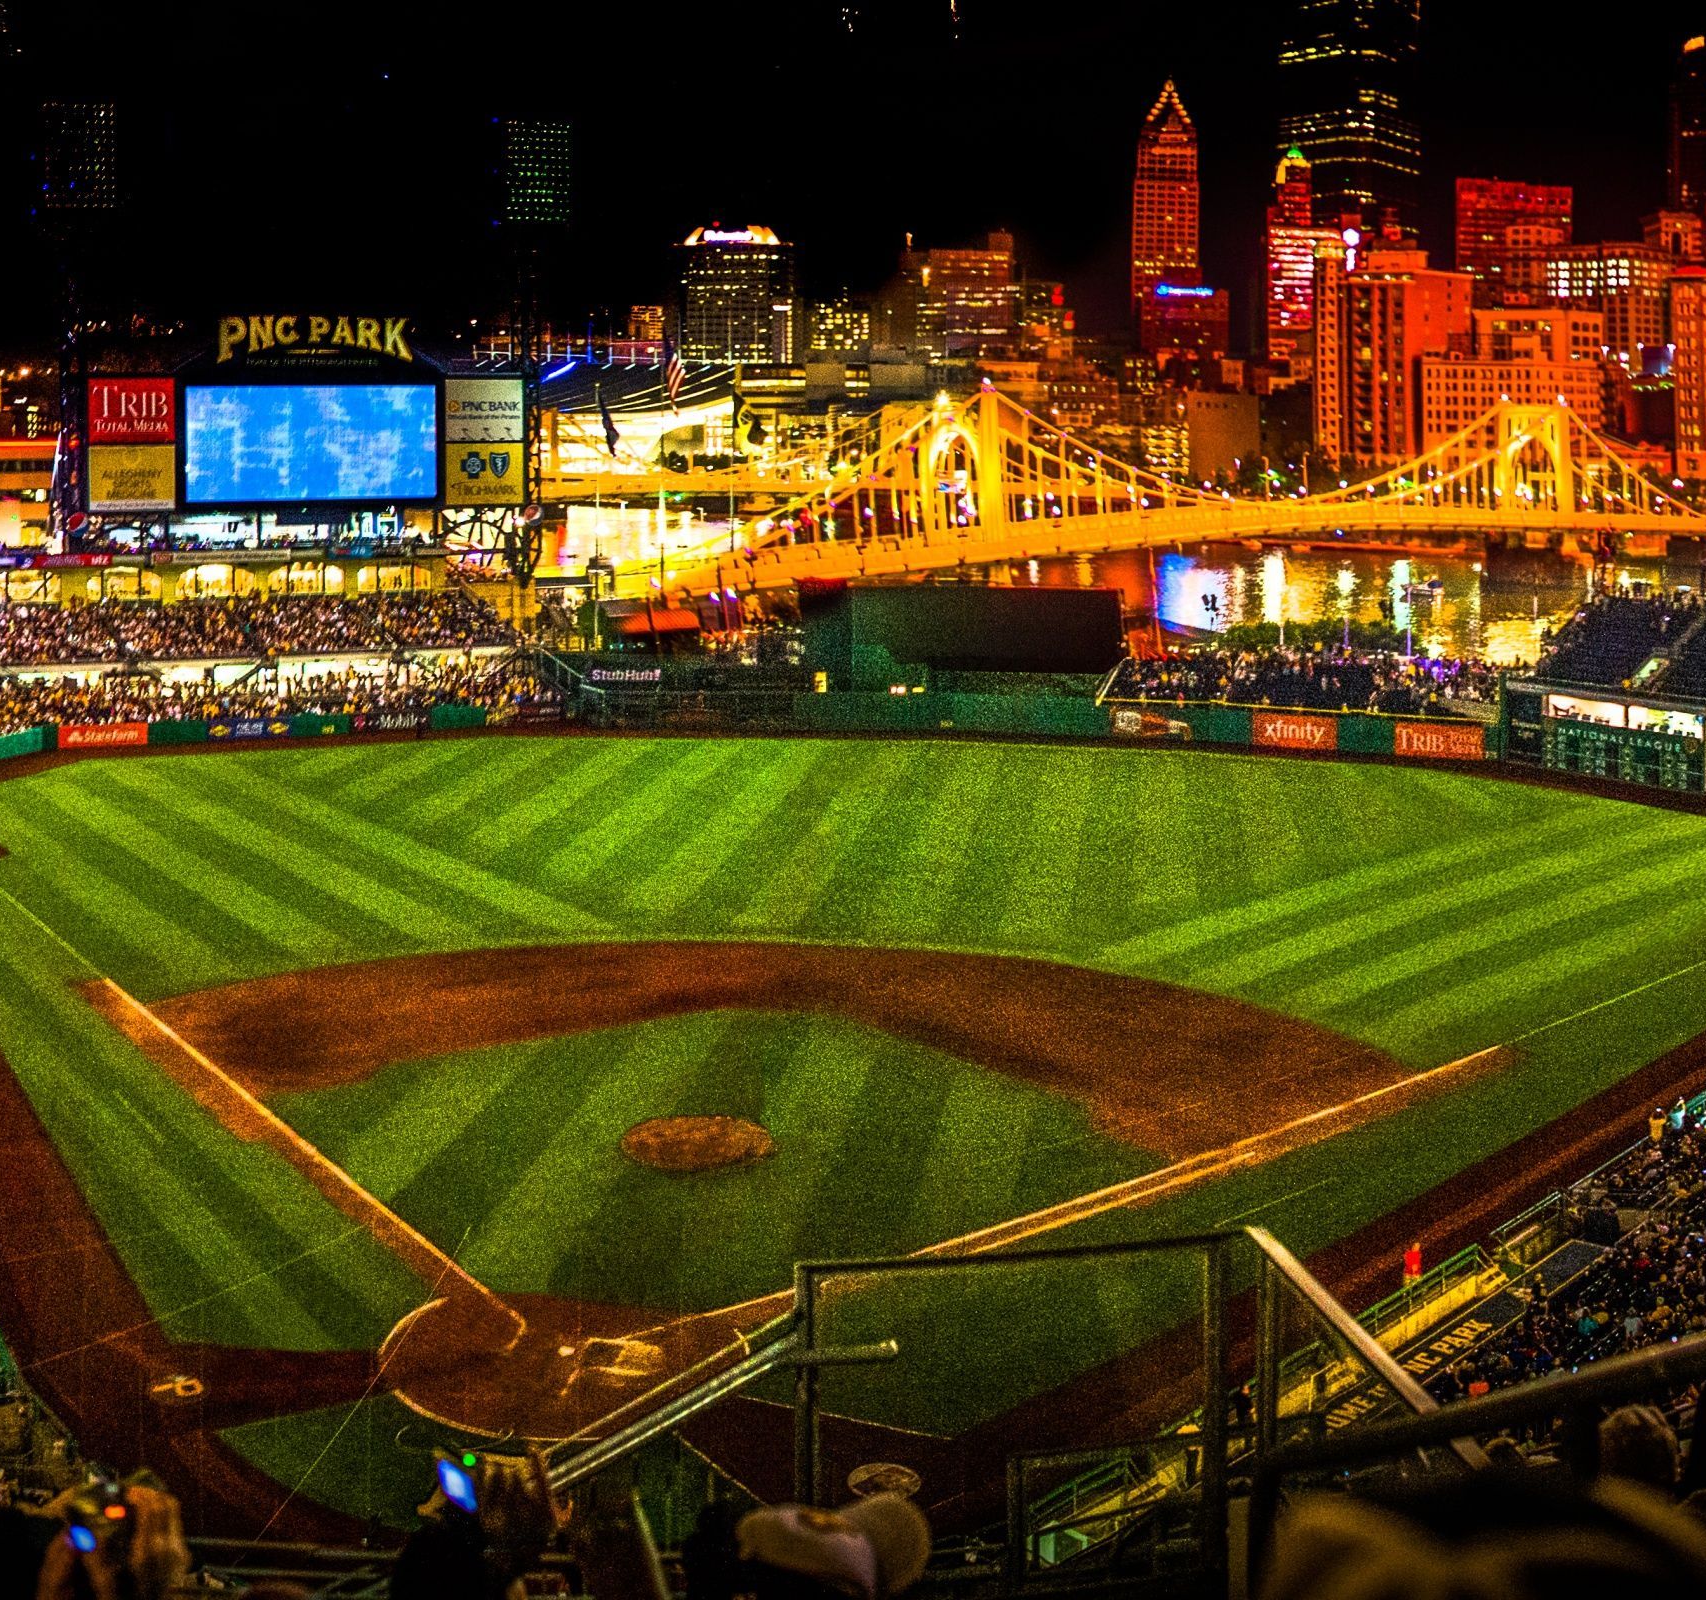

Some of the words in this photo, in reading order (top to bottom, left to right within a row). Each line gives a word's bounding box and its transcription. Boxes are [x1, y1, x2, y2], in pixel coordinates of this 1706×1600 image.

[217, 314, 300, 364] PNC
[308, 316, 413, 363] PARK
[93, 386, 169, 417] TRIB
[1265, 720, 1325, 745] xfinity
[1396, 728, 1444, 752] TRIB
[1557, 727, 1623, 744] NATIONAL
[1629, 737, 1681, 752] LEAGUE
[1402, 1352, 1442, 1374] NC
[1429, 1319, 1492, 1354] PARK
